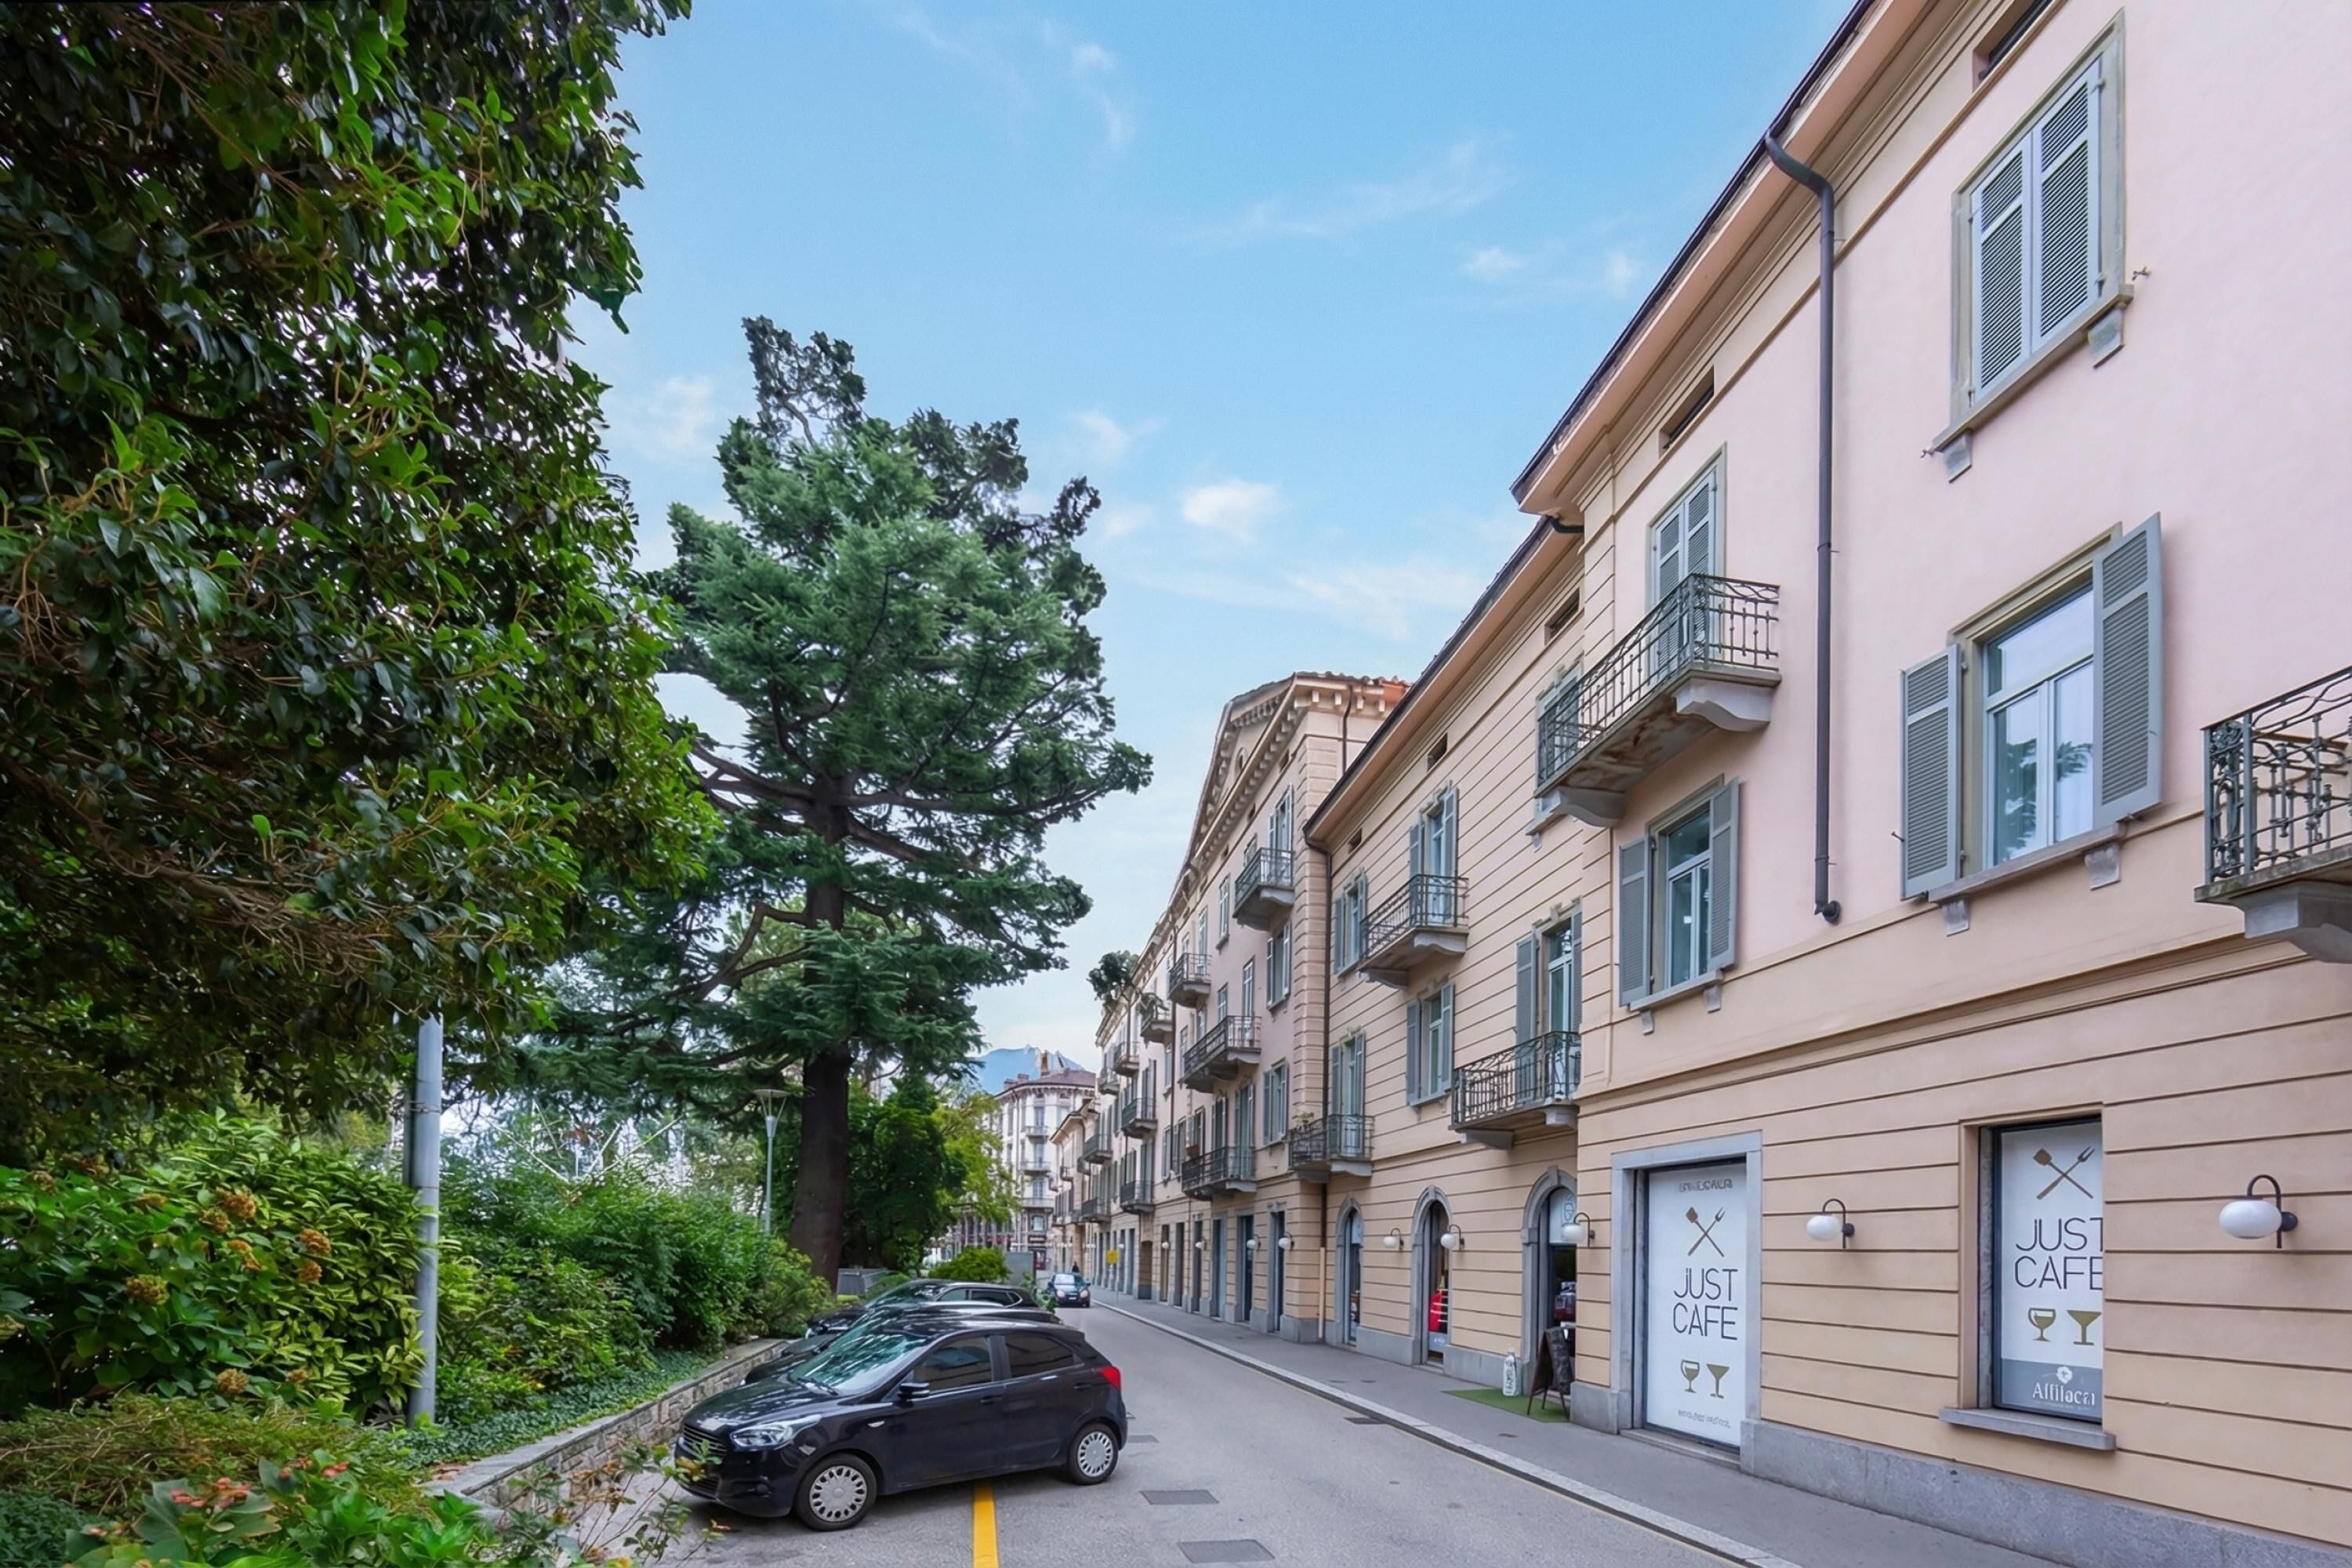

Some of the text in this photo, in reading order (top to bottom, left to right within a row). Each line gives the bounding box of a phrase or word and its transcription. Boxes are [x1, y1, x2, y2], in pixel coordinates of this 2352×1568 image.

[2015, 1218, 2103, 1252] JUST
[1674, 1268, 1738, 1301] JUST
[2015, 1255, 2103, 1290] CAFE
[1673, 1302, 1738, 1341] CAFE
